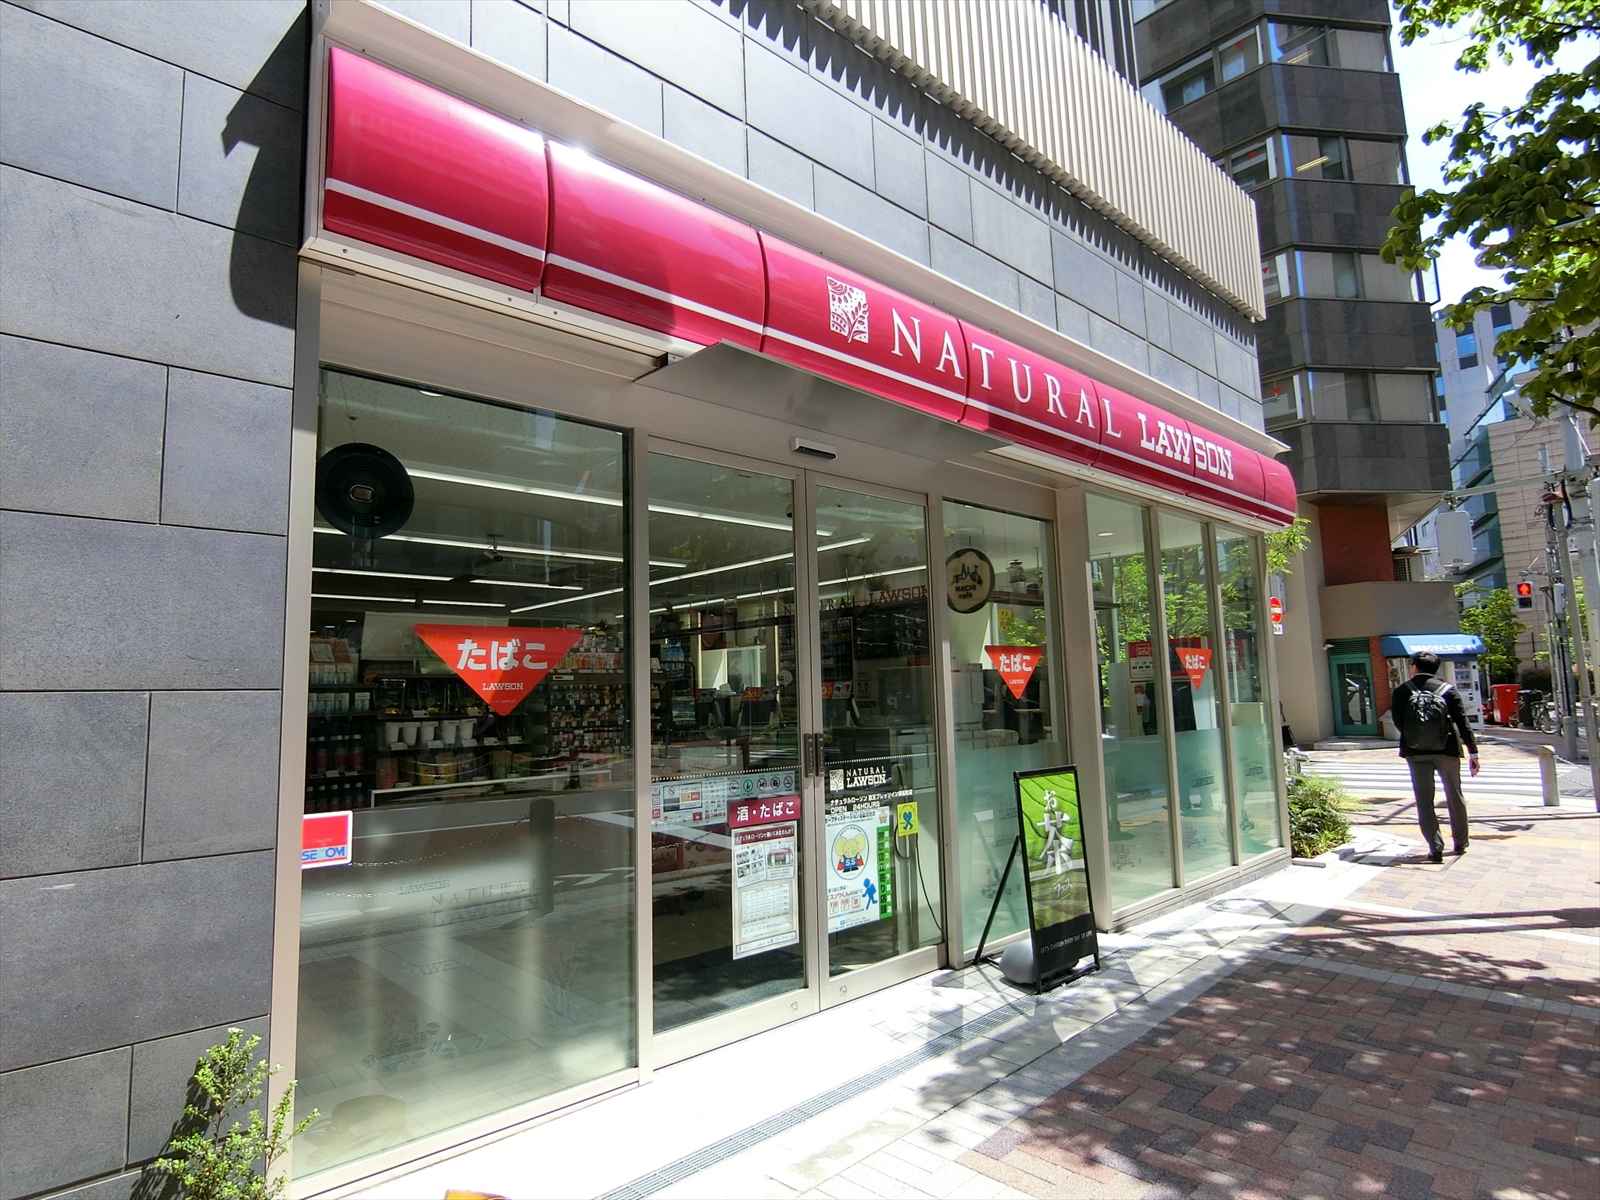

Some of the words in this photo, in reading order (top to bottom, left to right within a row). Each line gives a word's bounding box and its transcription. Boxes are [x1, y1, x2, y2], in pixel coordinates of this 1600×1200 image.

[890, 307, 1122, 438] NATURAL
[1137, 411, 1234, 481] LAWSON
[456, 638, 548, 671] たばこ
[1185, 653, 1206, 670] たばこ
[999, 653, 1032, 673] たばこ
[482, 682, 524, 691] LAWSON
[846, 766, 886, 777] NATURAL
[846, 774, 886, 788] LAWSON
[736, 801, 795, 821] 酒・たばこ
[830, 806, 847, 814] OPEN
[853, 801, 880, 811] 24HOURS
[1036, 789, 1074, 876] お茶
[302, 846, 345, 861] SECOM
[845, 858, 856, 866] SS
